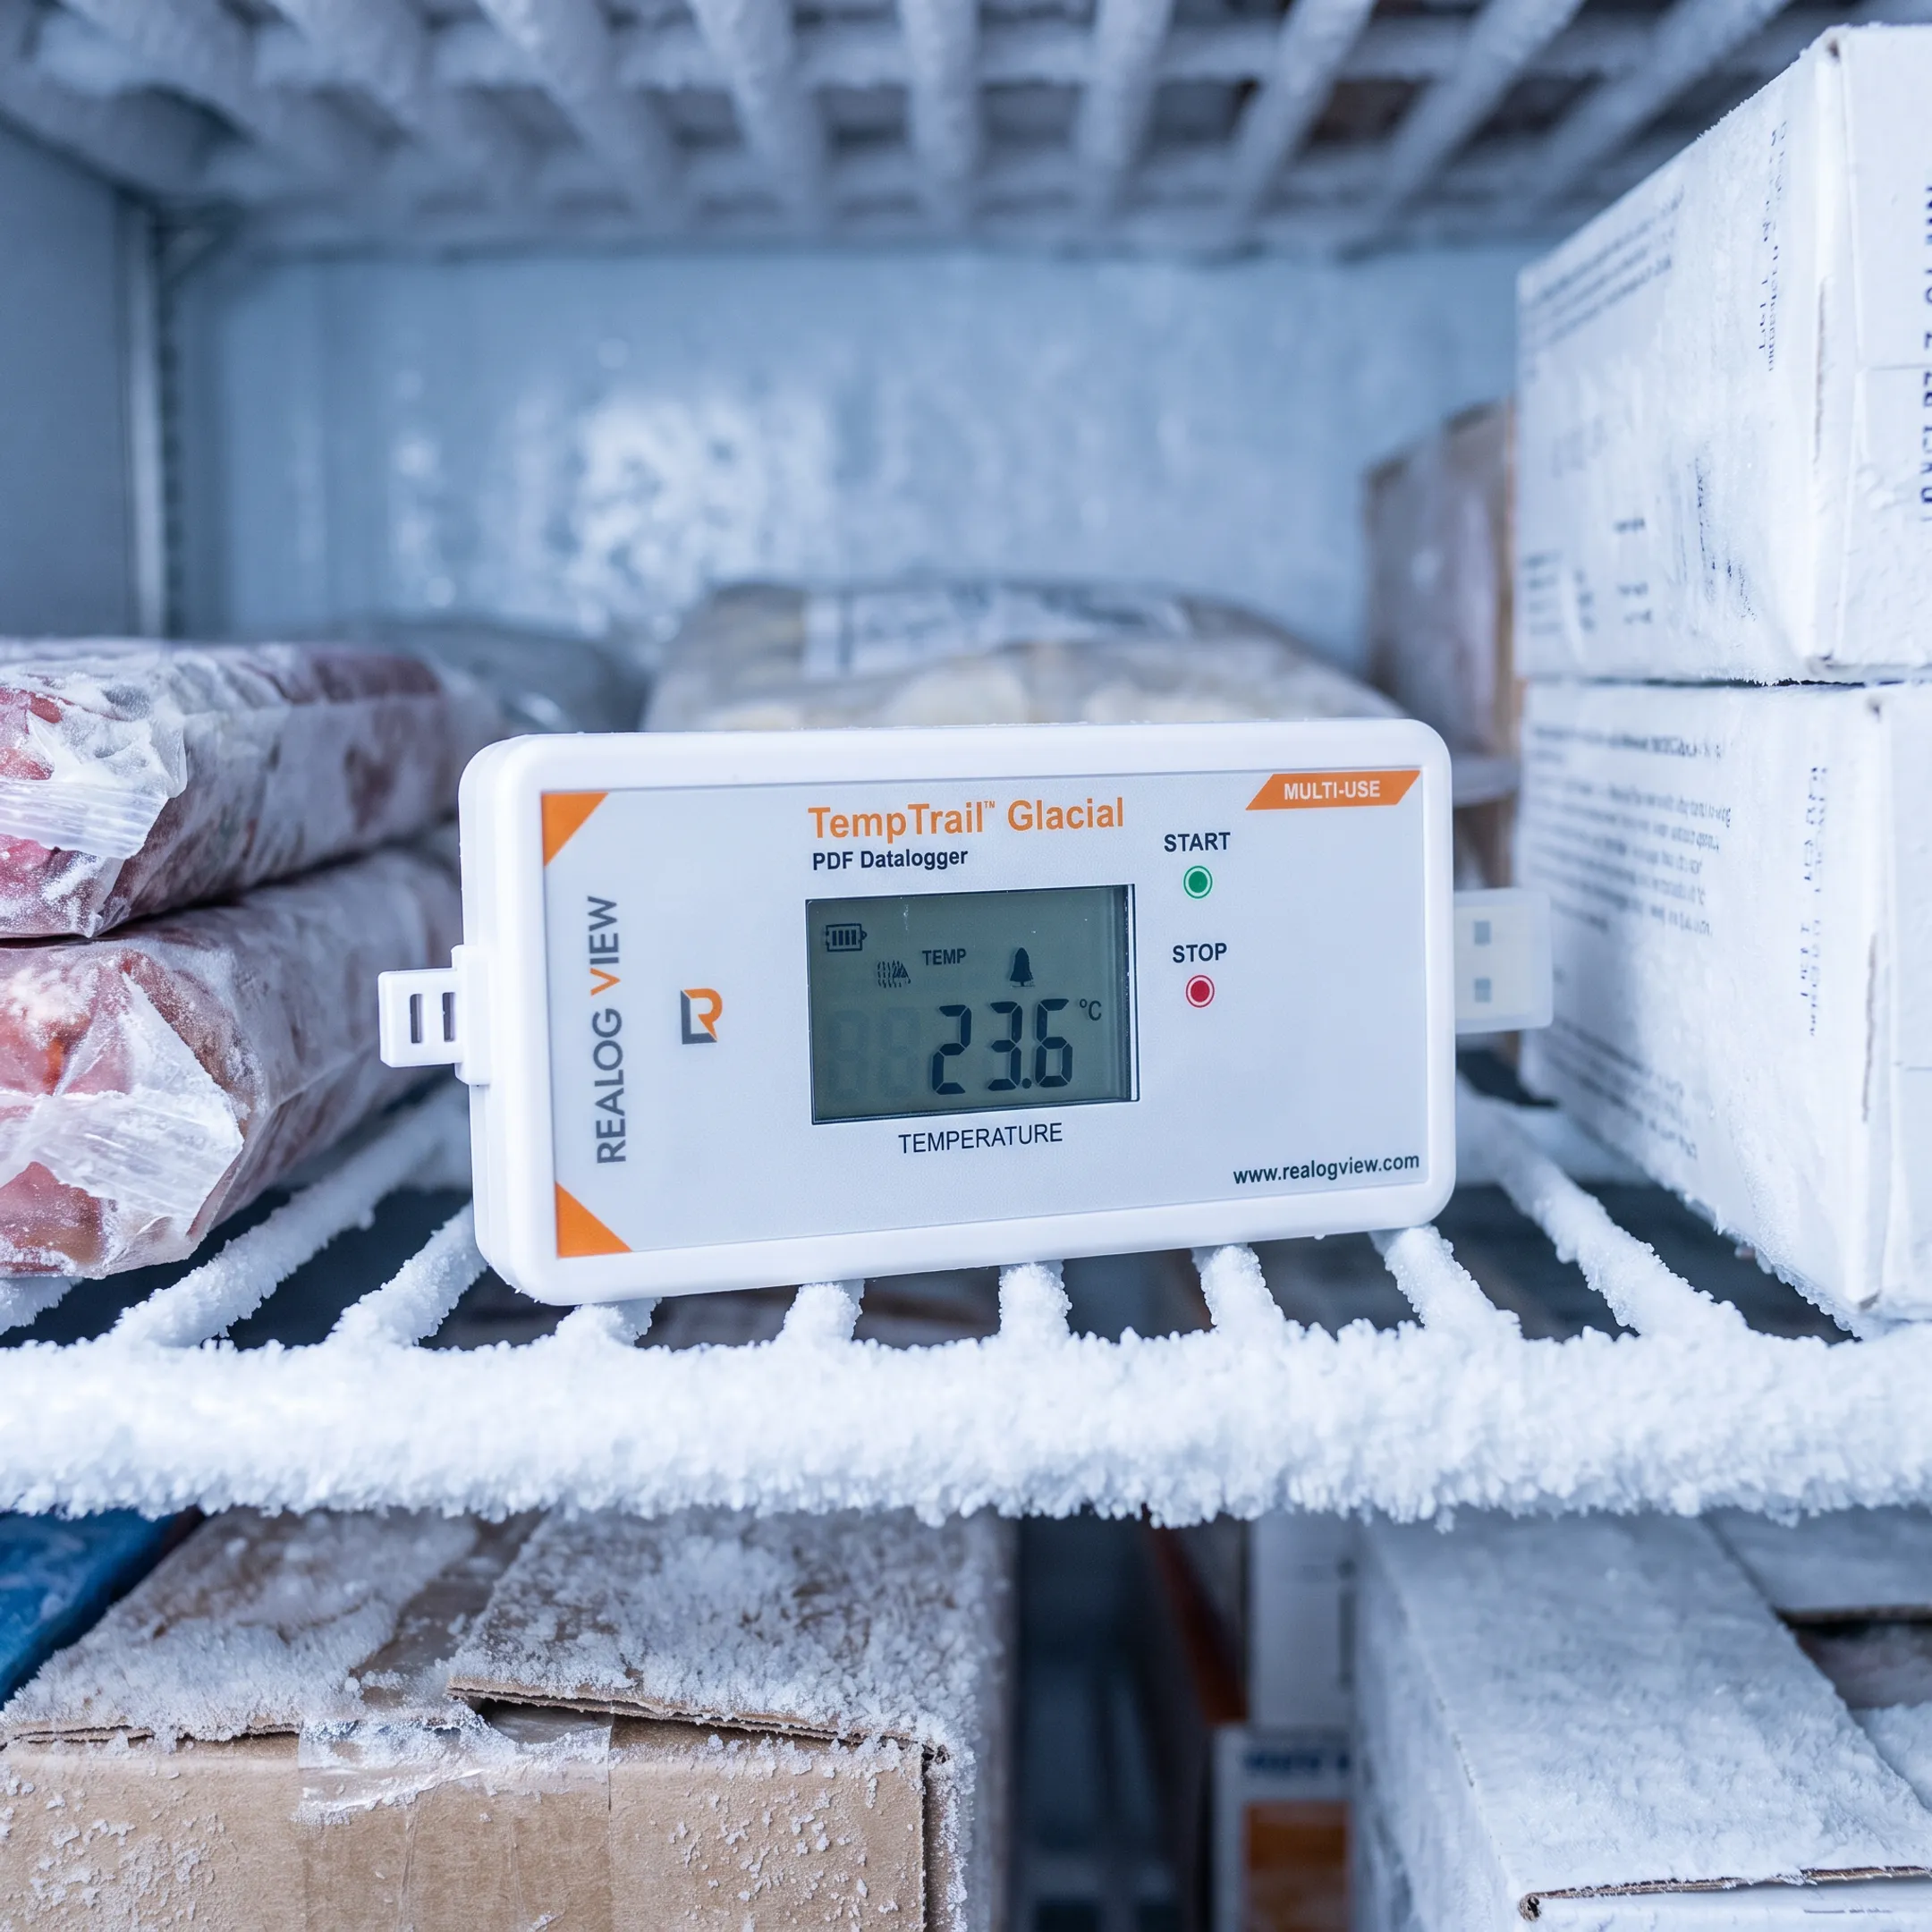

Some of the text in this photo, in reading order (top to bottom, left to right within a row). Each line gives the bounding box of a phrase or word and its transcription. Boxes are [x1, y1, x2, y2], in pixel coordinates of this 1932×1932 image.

[1284, 780, 1381, 801] MULTI-USE
[1007, 797, 1123, 832] Glacial
[1164, 832, 1231, 852] START
[813, 849, 969, 871] PDF Datalogger
[922, 948, 967, 966] TEMP
[1173, 942, 1228, 963] STOP
[587, 895, 627, 1164] REALOG VIEW
[931, 997, 1073, 1096] 23.6
[898, 1123, 1063, 1154] TEMPERATURE
[1233, 1154, 1420, 1185] www.realogview.com
